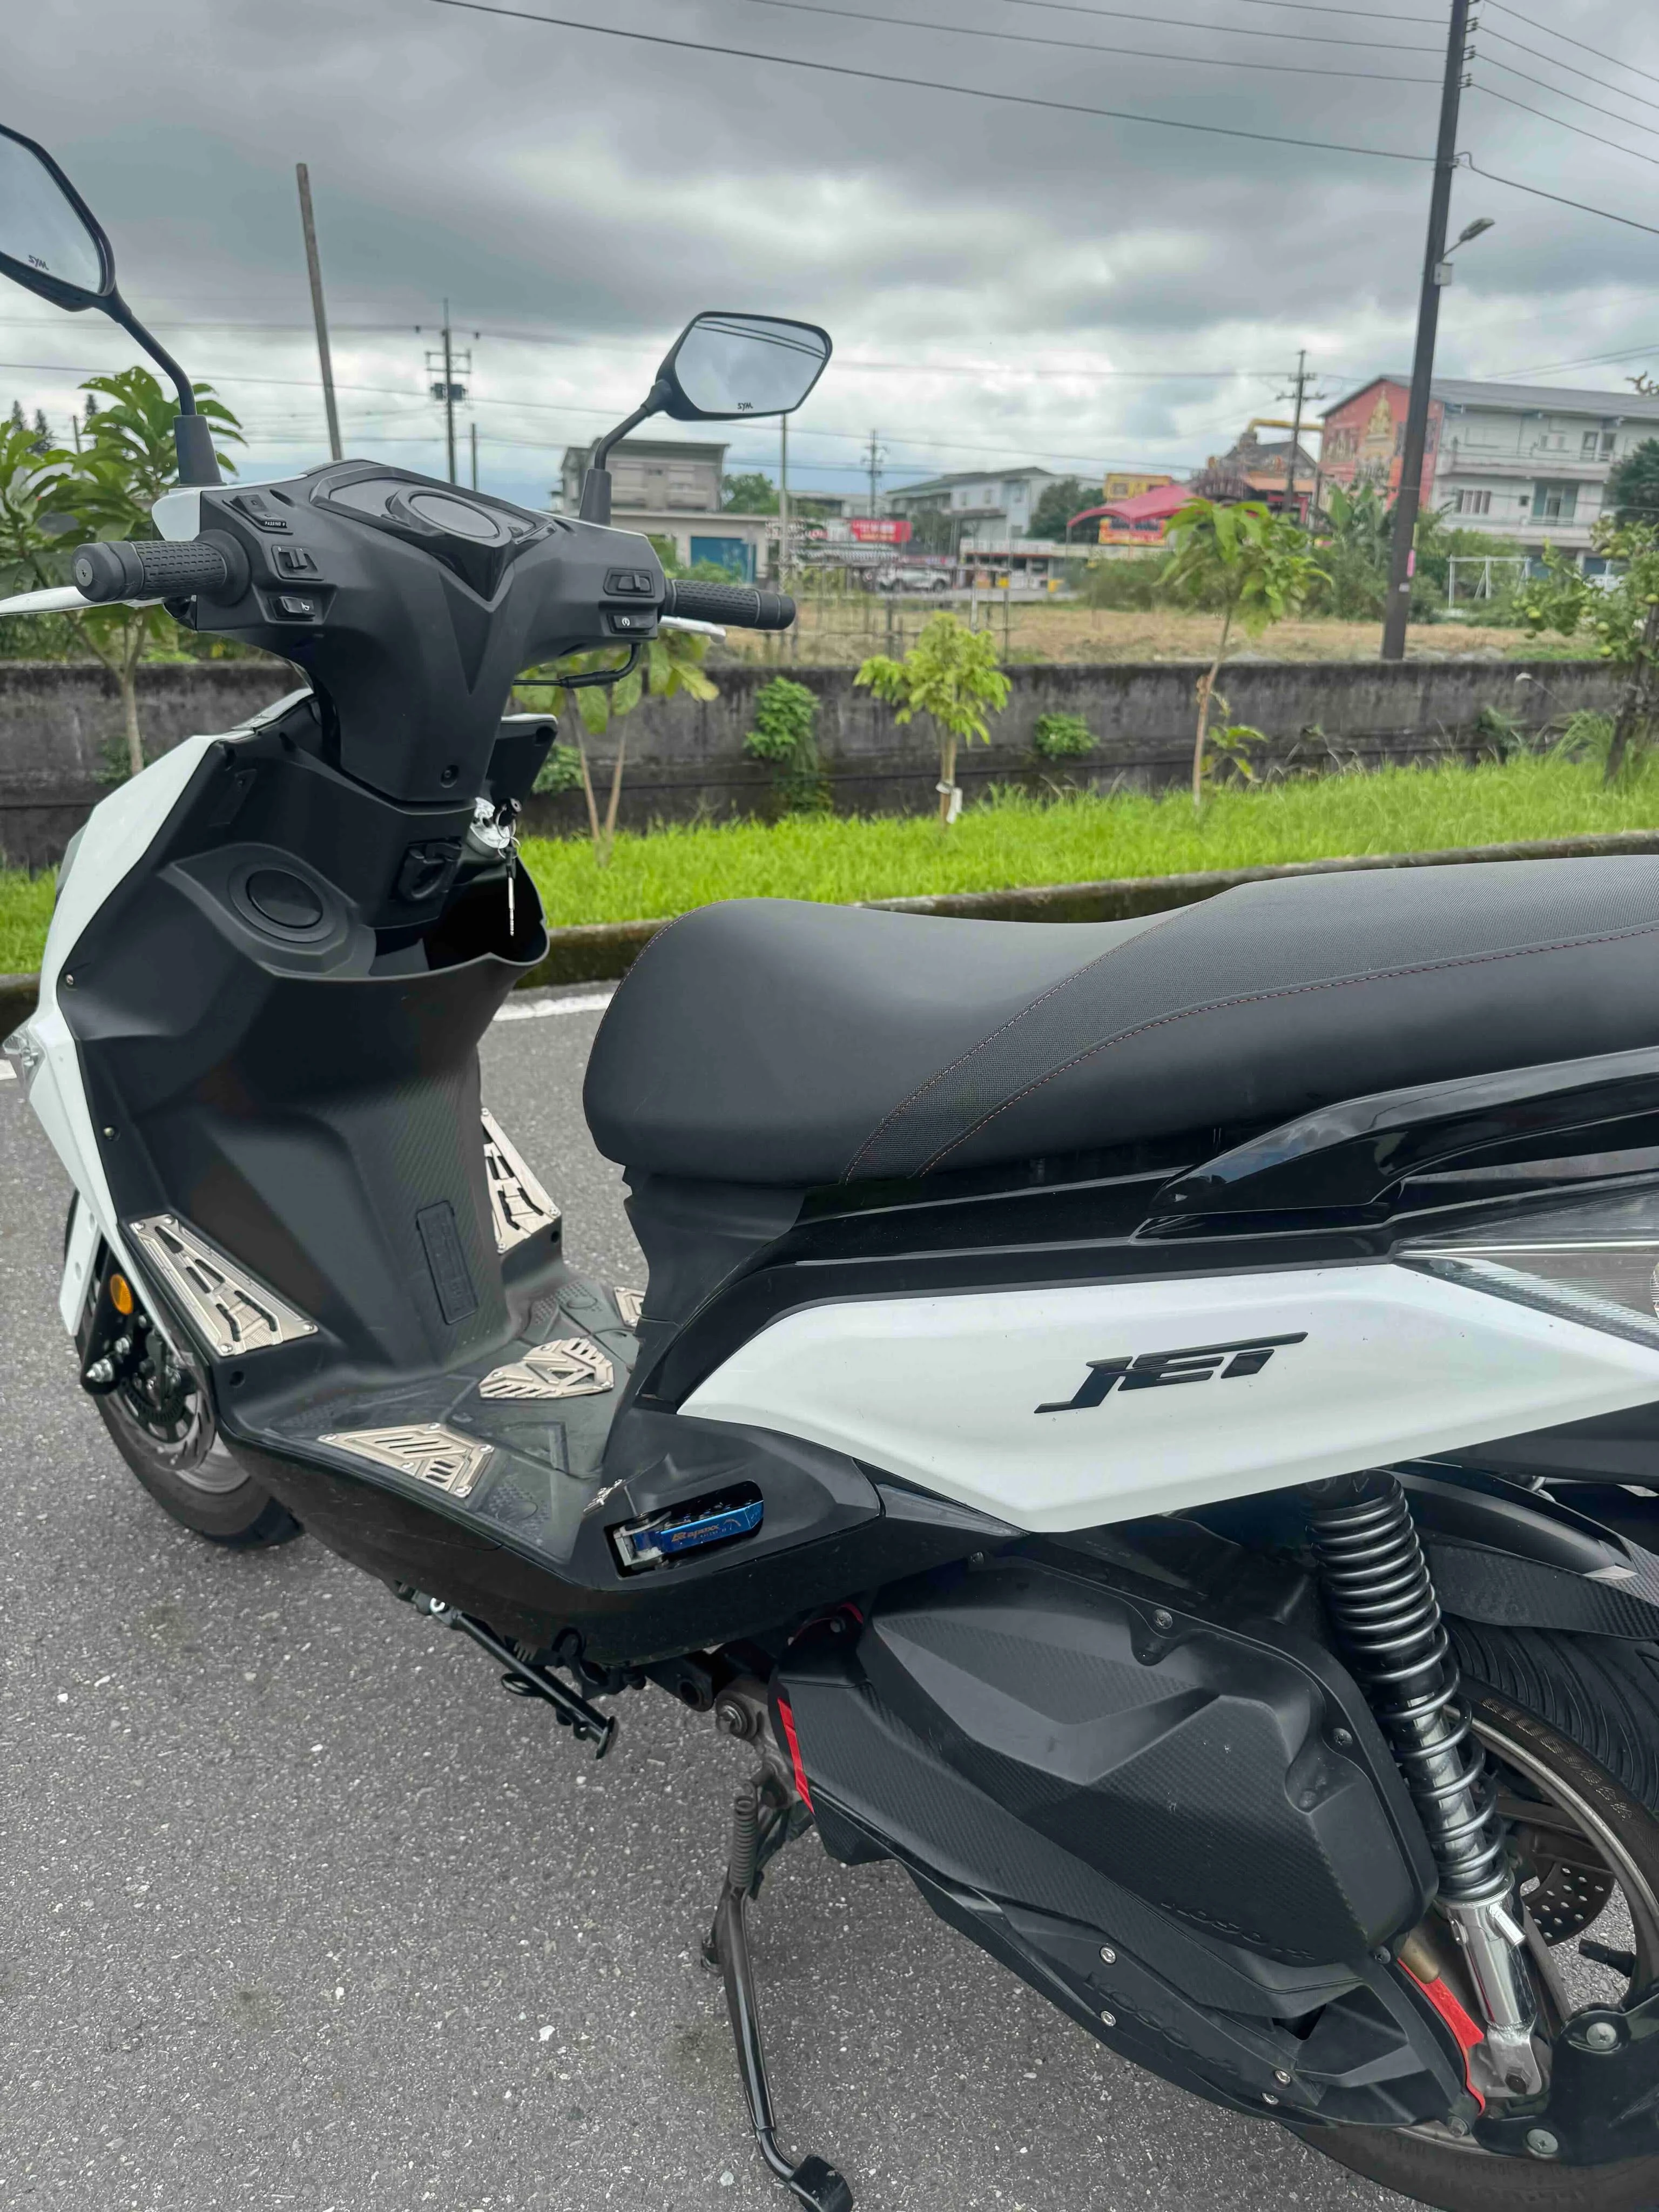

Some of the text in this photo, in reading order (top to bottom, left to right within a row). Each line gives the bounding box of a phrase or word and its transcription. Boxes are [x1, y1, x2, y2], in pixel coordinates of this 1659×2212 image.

[28, 254, 49, 271] SYM
[737, 402, 753, 411] SYM
[1034, 1331, 1309, 1414] JET
